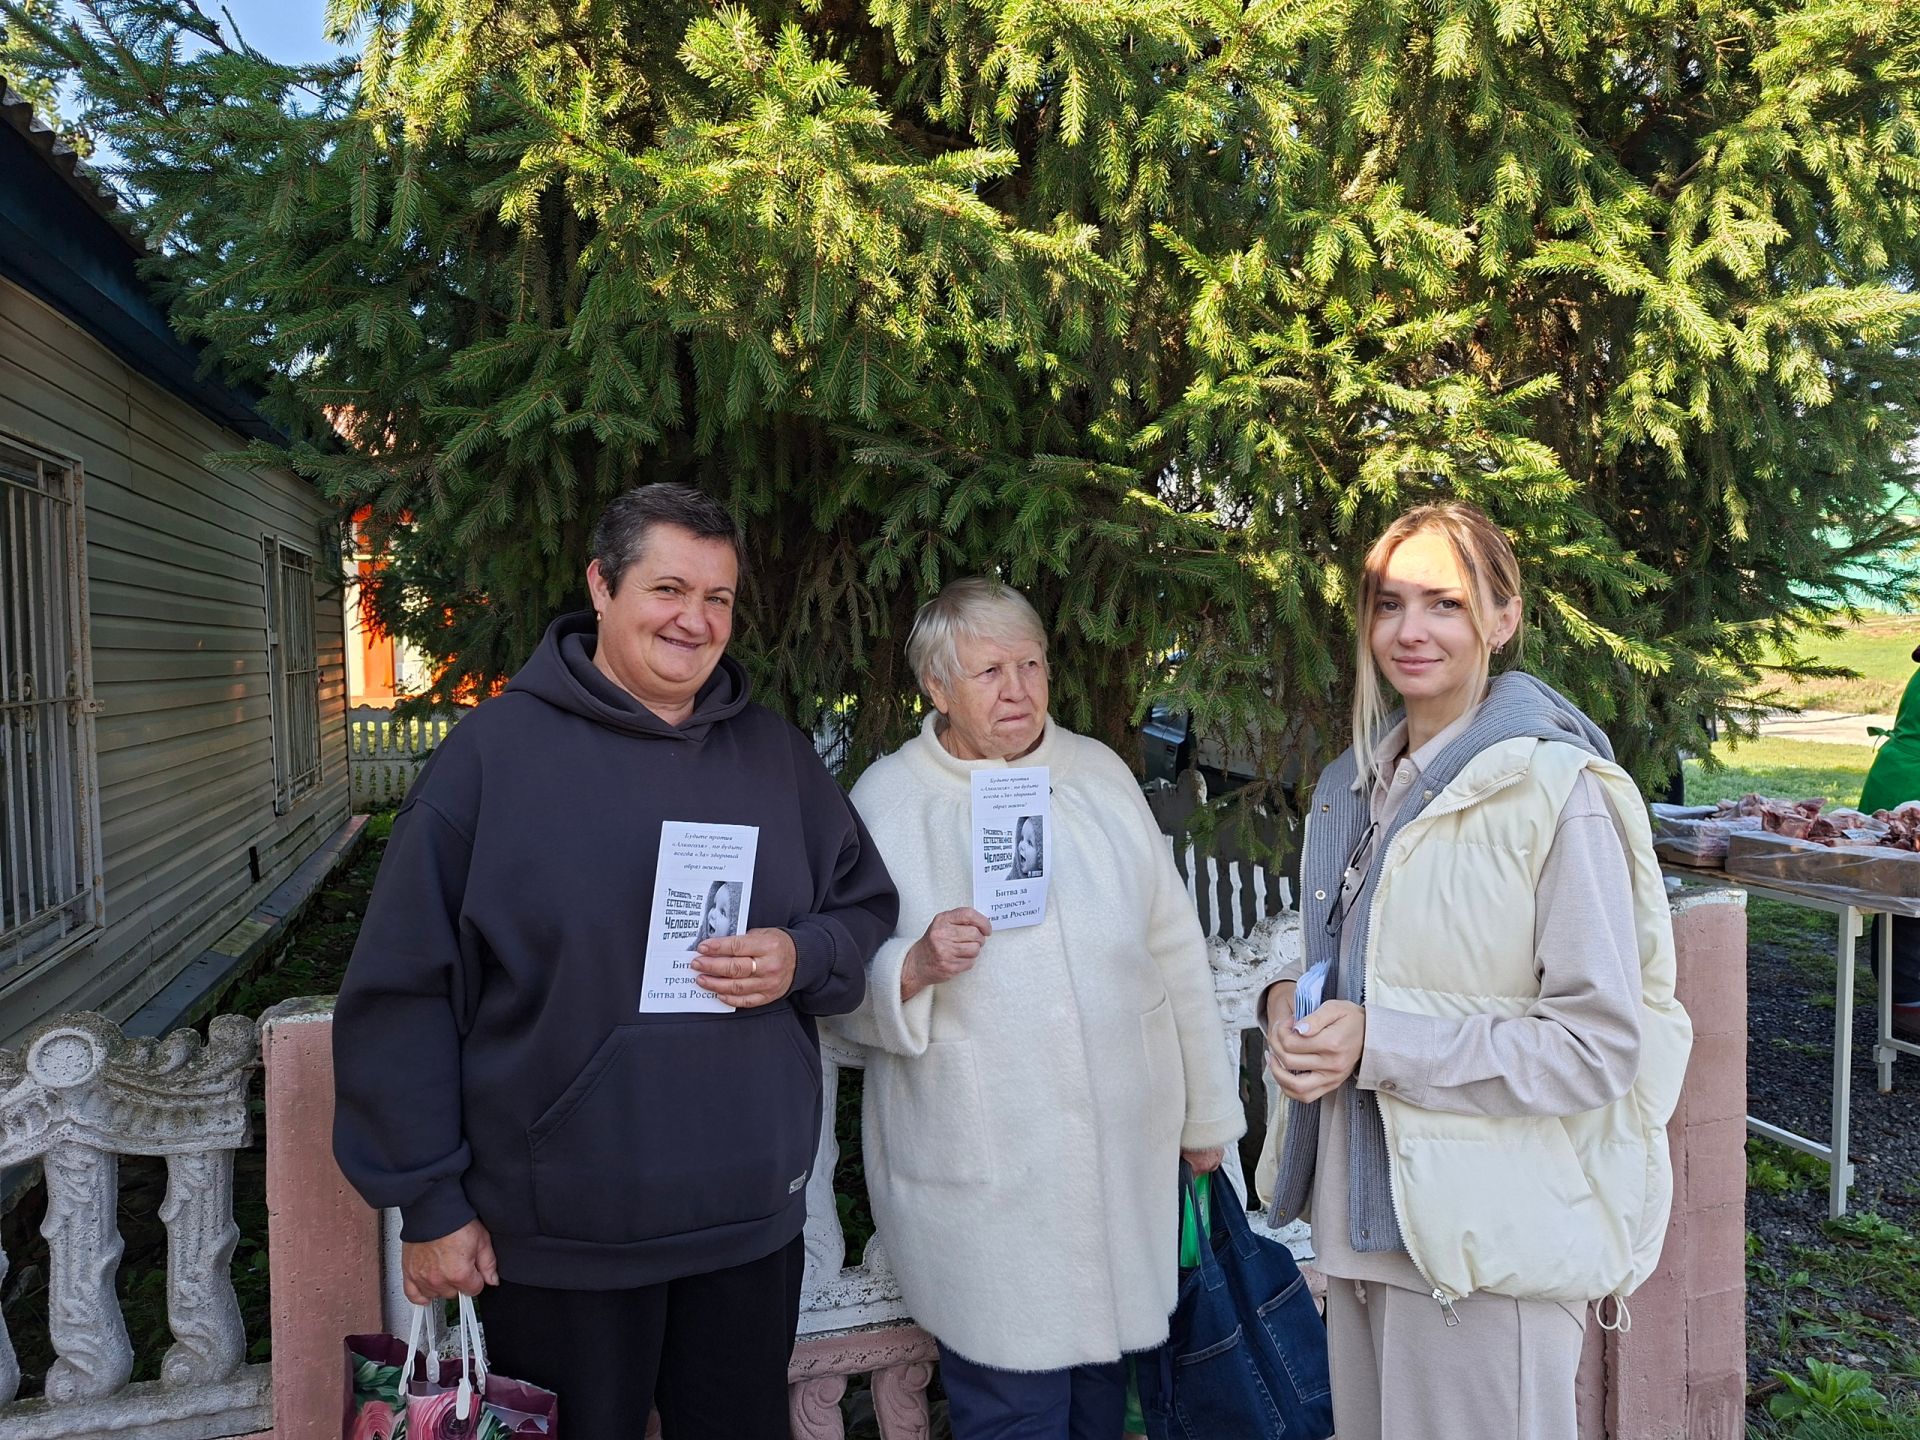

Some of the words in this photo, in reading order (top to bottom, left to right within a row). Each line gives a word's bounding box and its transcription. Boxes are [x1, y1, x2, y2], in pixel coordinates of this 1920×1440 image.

[996, 889, 1018, 898] Битва
[991, 900, 1026, 912] трезвость
[1010, 907, 1040, 918] Россию!
[672, 960, 691, 969] Бит
[664, 977, 696, 986] трезво
[648, 990, 674, 999] битва
[690, 990, 718, 1000] Росси
